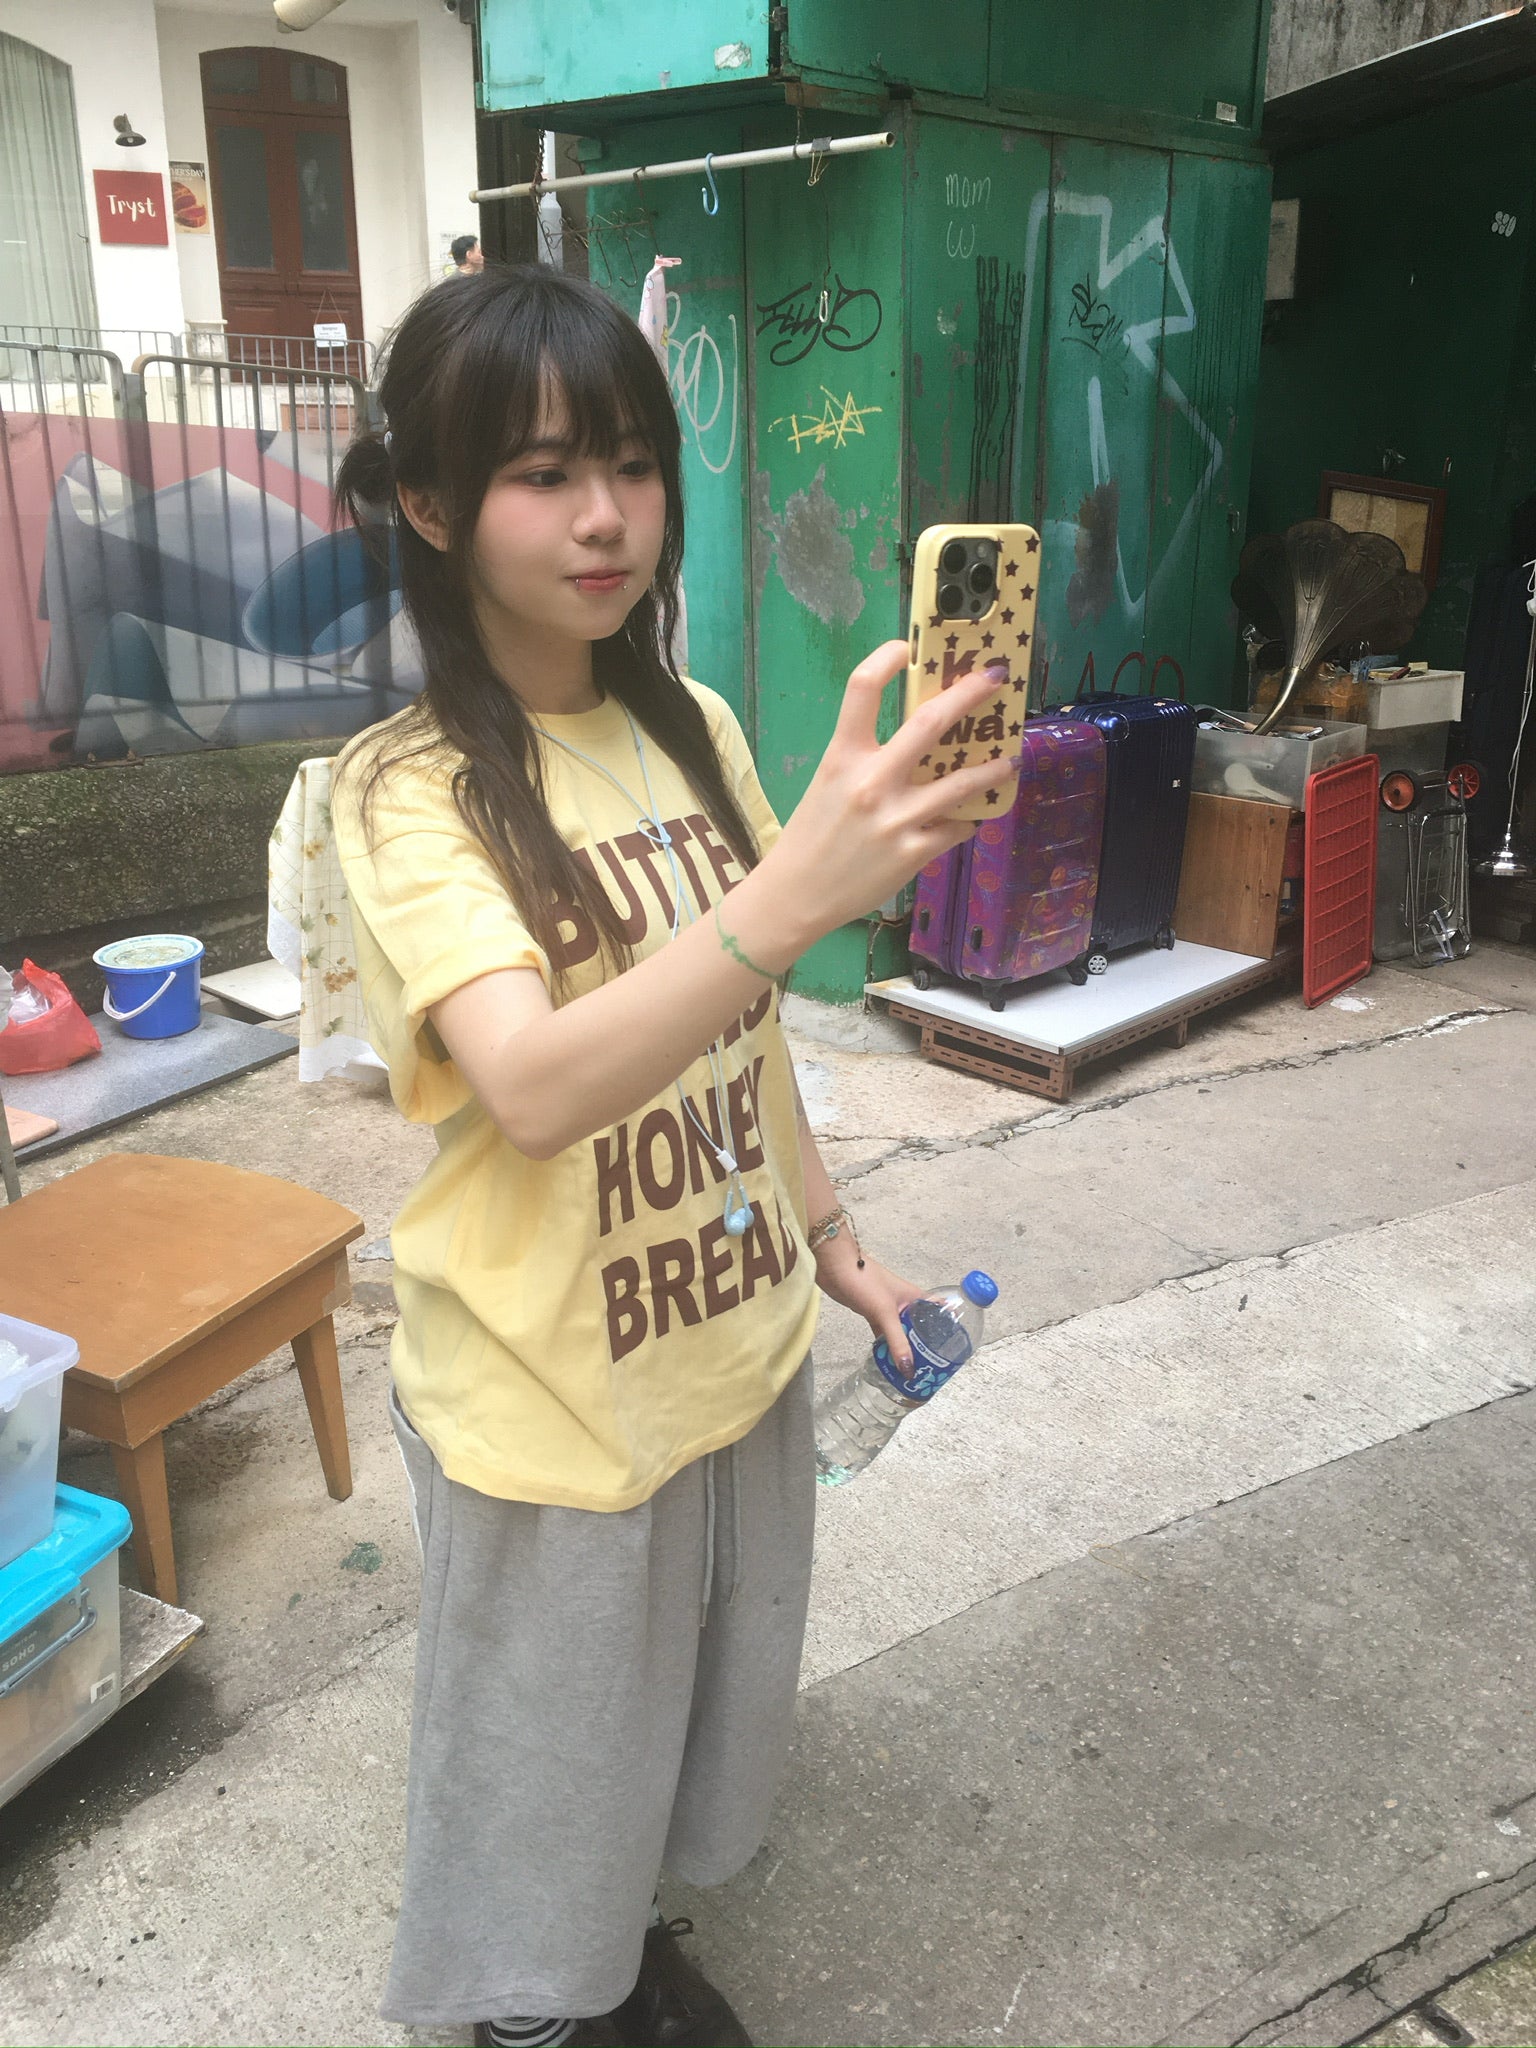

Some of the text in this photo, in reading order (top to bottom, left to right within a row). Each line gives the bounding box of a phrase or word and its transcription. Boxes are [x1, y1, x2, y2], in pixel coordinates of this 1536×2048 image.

[105, 194, 157, 222] Tryst
[549, 813, 751, 973] BUTTE
[593, 1054, 765, 1238] HONEY
[601, 1190, 798, 1365] BREAD
[2, 1643, 35, 1672] SOHO
